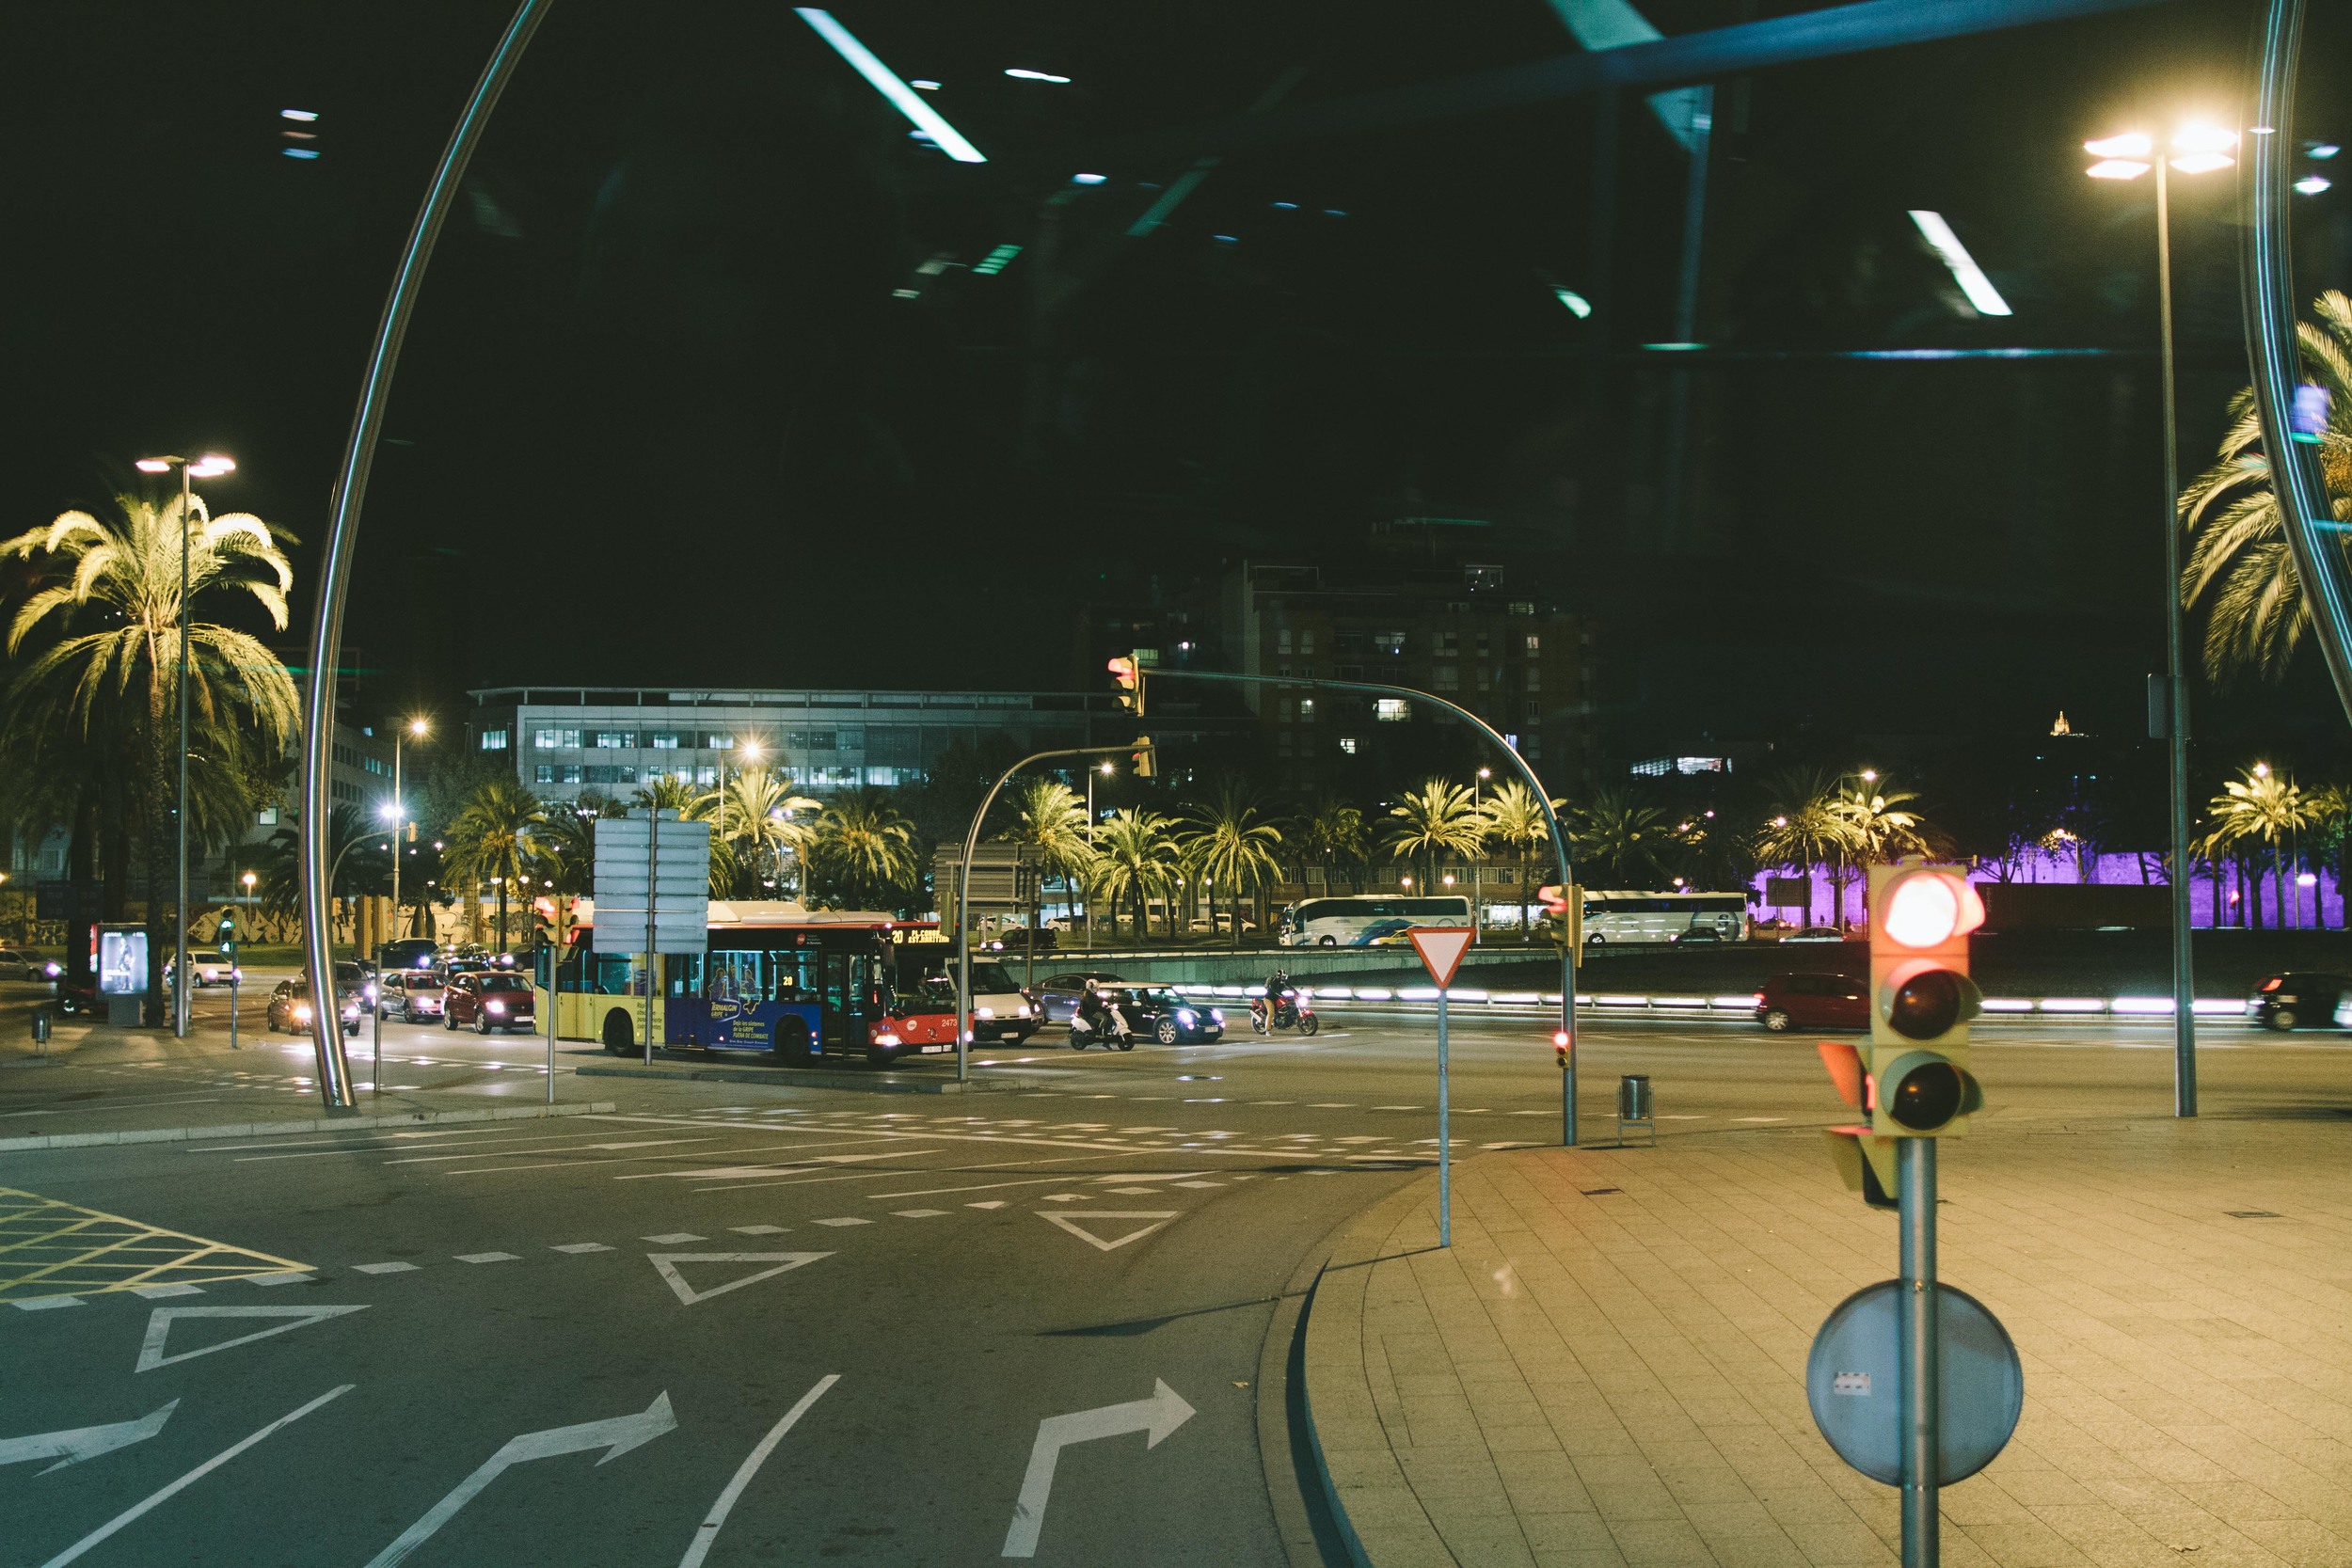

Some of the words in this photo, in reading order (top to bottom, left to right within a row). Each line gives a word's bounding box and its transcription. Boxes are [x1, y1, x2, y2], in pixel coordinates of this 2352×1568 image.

[892, 930, 903, 943] 20
[783, 975, 793, 986] 20
[711, 1002, 738, 1011] TERMALGIN
[942, 1019, 958, 1027] 2473
